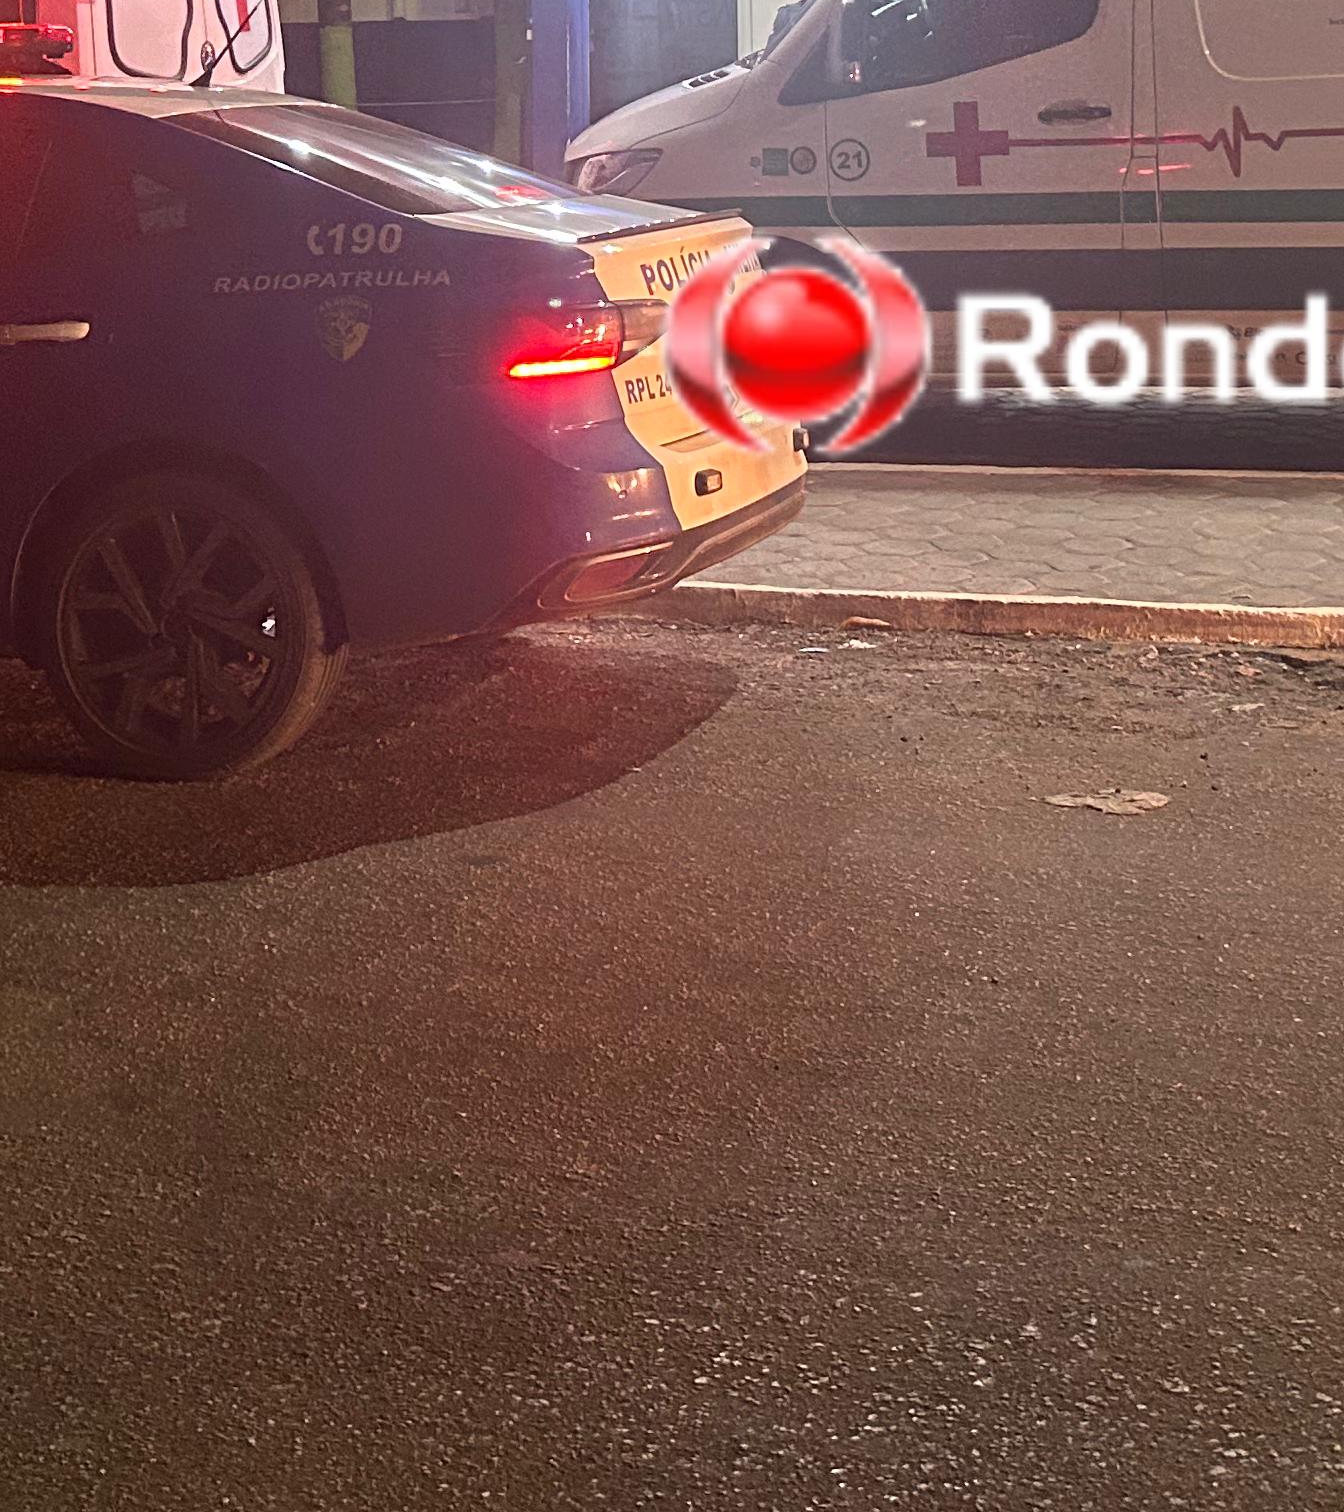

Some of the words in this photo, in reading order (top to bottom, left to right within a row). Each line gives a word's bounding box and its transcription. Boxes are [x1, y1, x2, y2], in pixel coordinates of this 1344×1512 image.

[836, 150, 864, 170] 21
[326, 222, 404, 256] 190
[212, 269, 453, 294] RADIOPATRULHA
[624, 375, 656, 405] RPL
